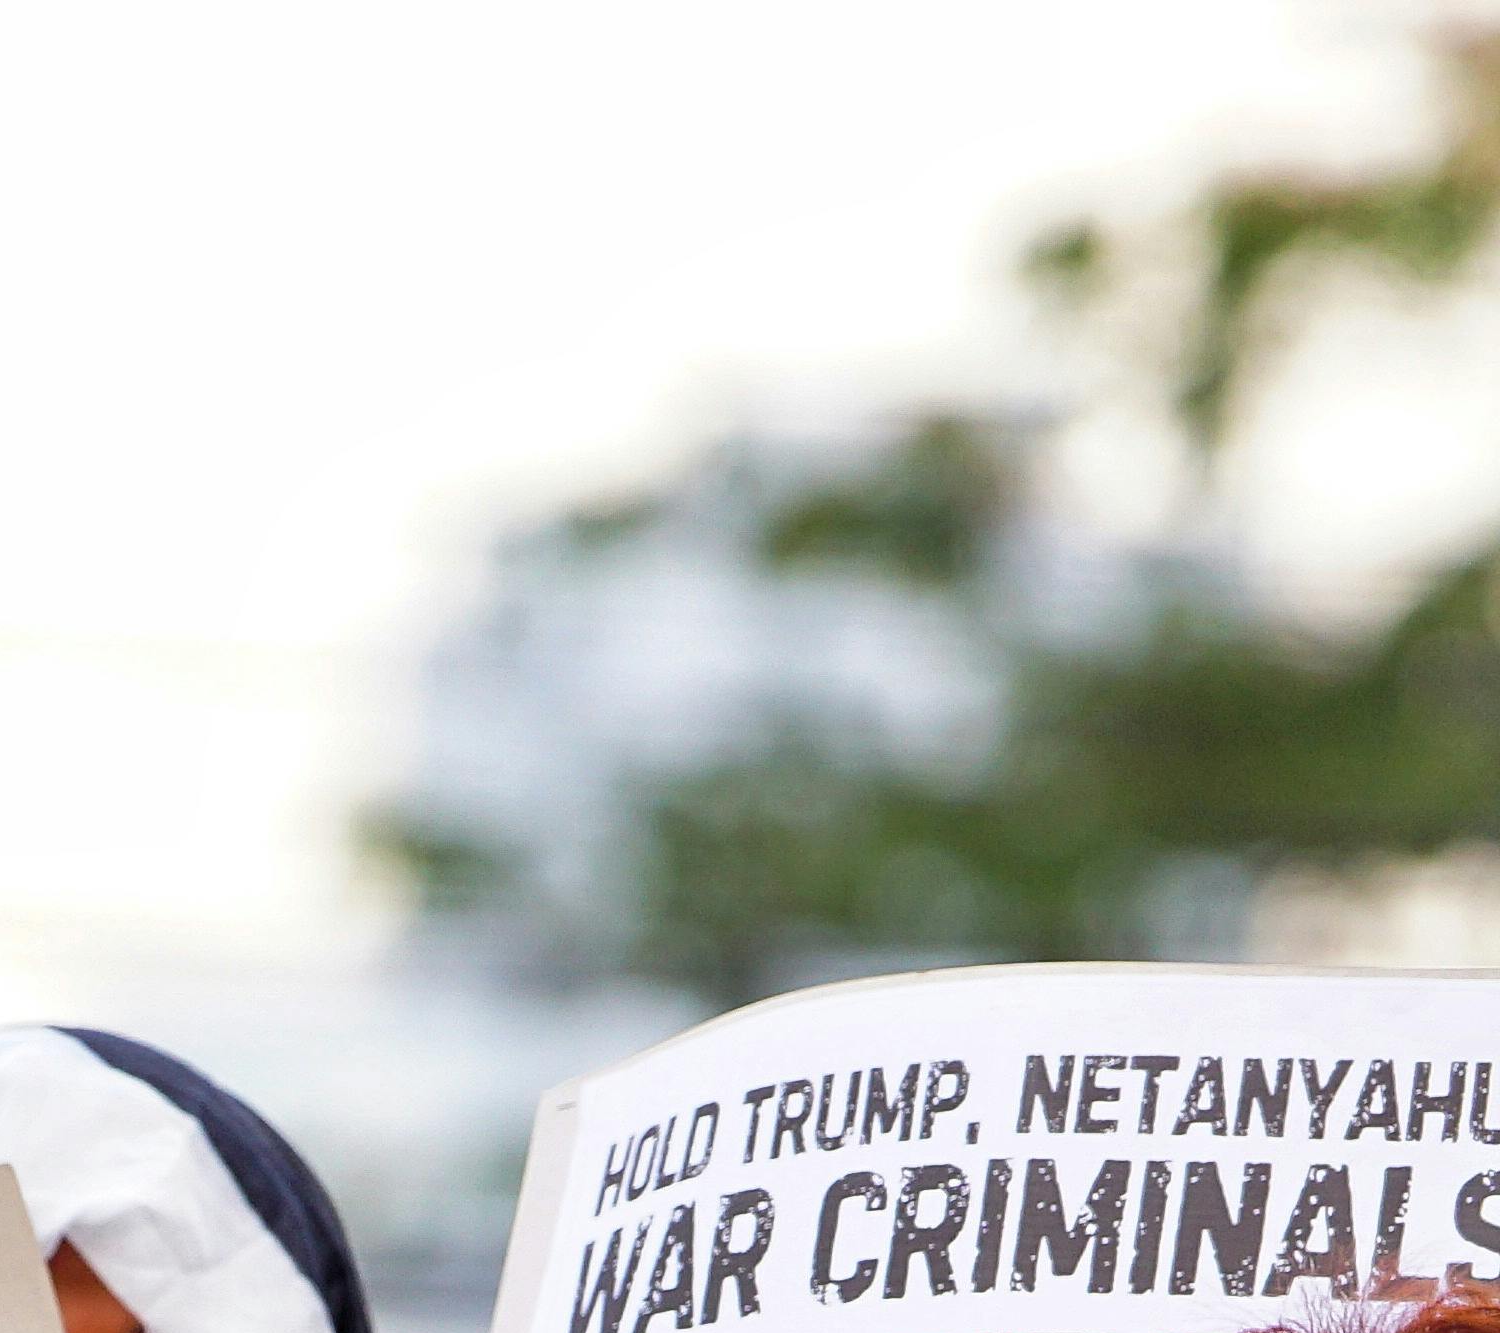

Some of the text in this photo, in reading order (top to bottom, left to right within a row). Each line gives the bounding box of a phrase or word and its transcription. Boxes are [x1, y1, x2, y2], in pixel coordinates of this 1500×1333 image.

[595, 1101, 720, 1217] HOLD
[743, 1060, 980, 1164] TRUMP,
[810, 1158, 1500, 1304] CRIMINALS
